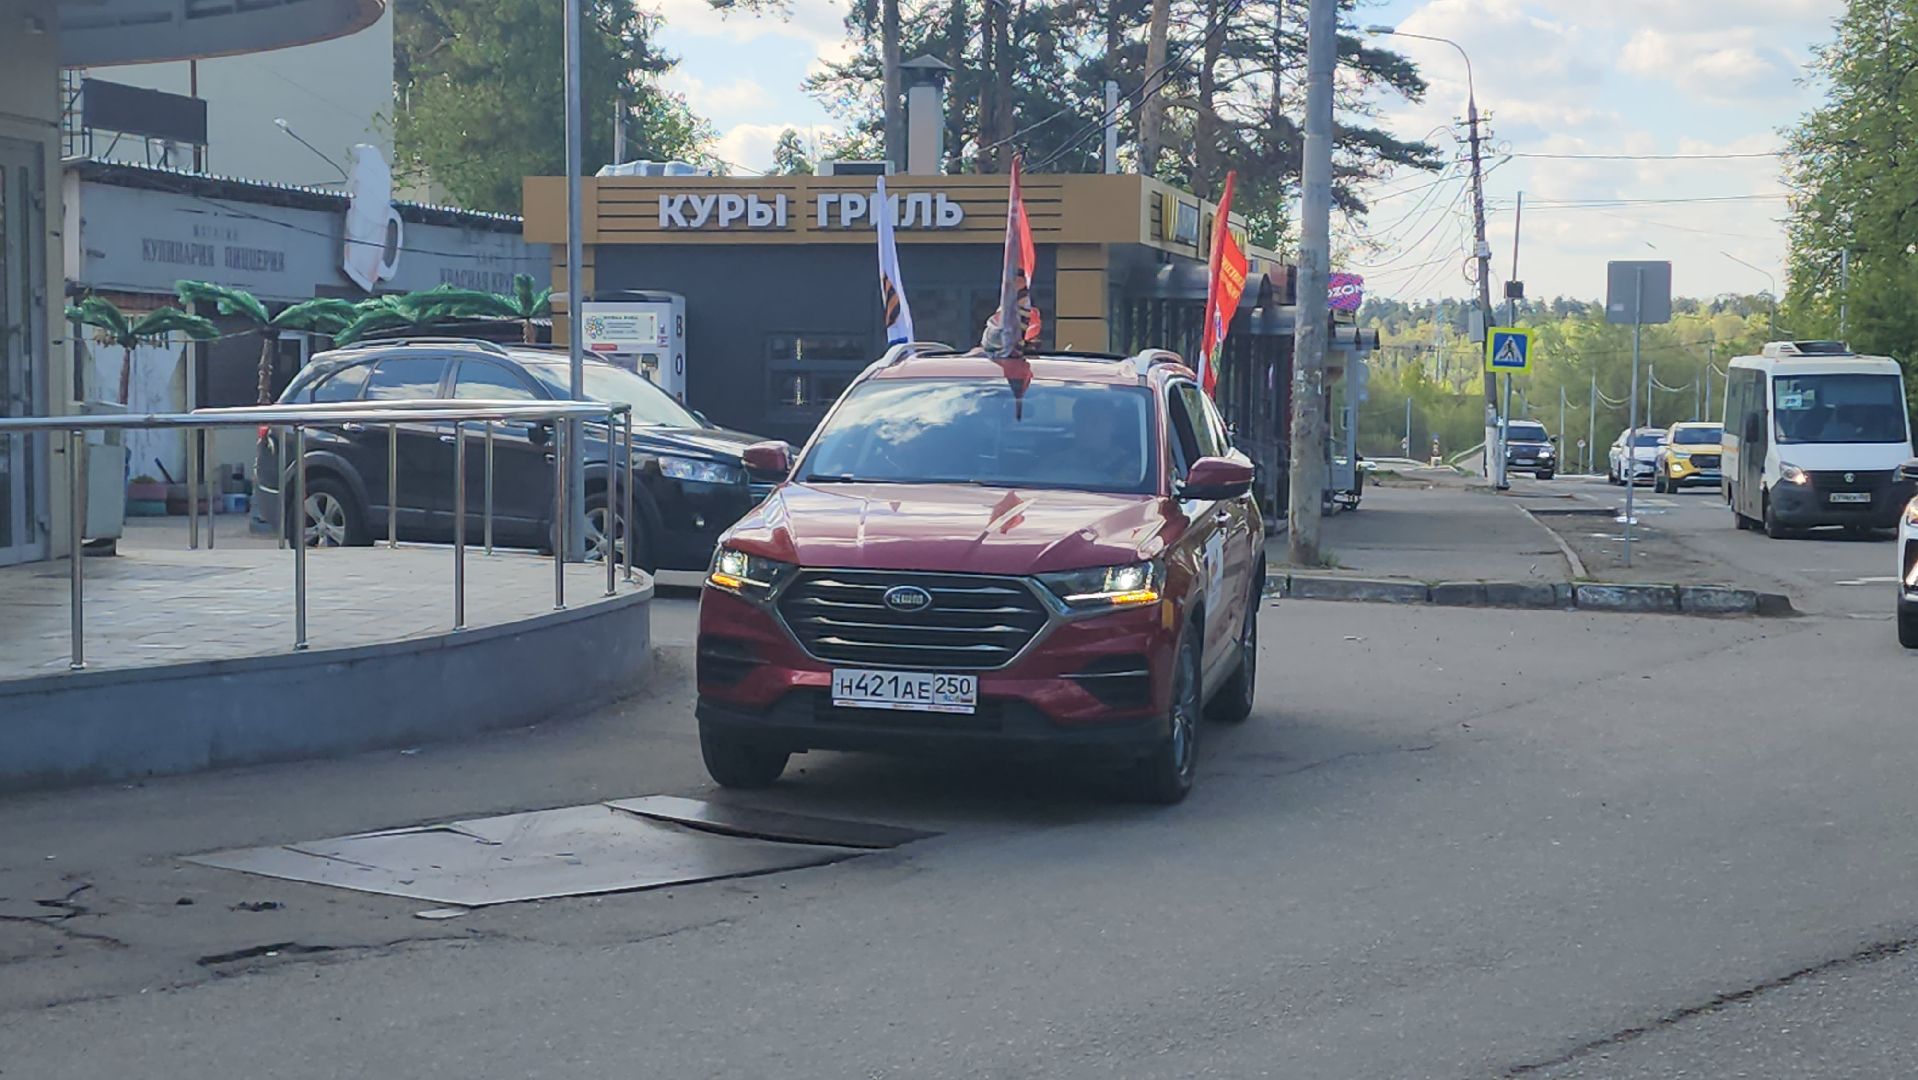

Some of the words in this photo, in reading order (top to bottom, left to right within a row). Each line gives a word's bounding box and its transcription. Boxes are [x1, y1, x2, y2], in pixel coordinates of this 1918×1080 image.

[658, 194, 787, 228] КУРЫ
[817, 192, 965, 228] ГРИЛЬ
[142, 238, 215, 267] КУЛИНАРИЯ
[224, 246, 285, 273] ПИЦЦЕРИЯ
[492, 270, 516, 297] КРУ
[840, 673, 931, 700] Н421АЕ
[935, 676, 971, 695] 250
